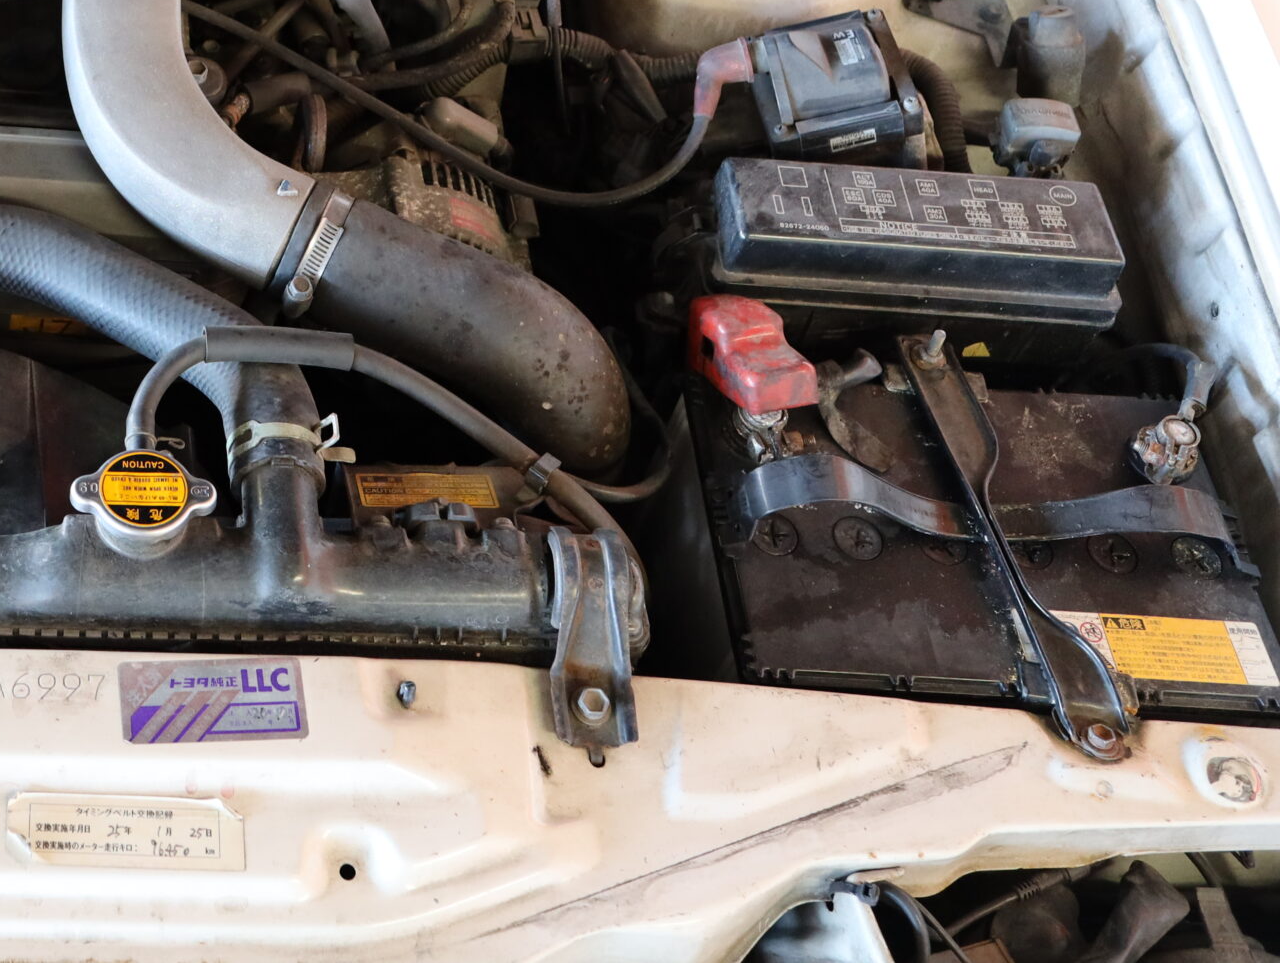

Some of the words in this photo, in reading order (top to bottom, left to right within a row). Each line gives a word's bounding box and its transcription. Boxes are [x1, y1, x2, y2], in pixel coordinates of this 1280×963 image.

[973, 186, 994, 194] HEAD
[1053, 192, 1073, 200] MAIN
[879, 221, 918, 230] NOTICE
[122, 460, 164, 469] CAUTION
[1119, 618, 1144, 630] 危険
[169, 676, 238, 689] トヨタ純正
[240, 667, 290, 693] LLC
